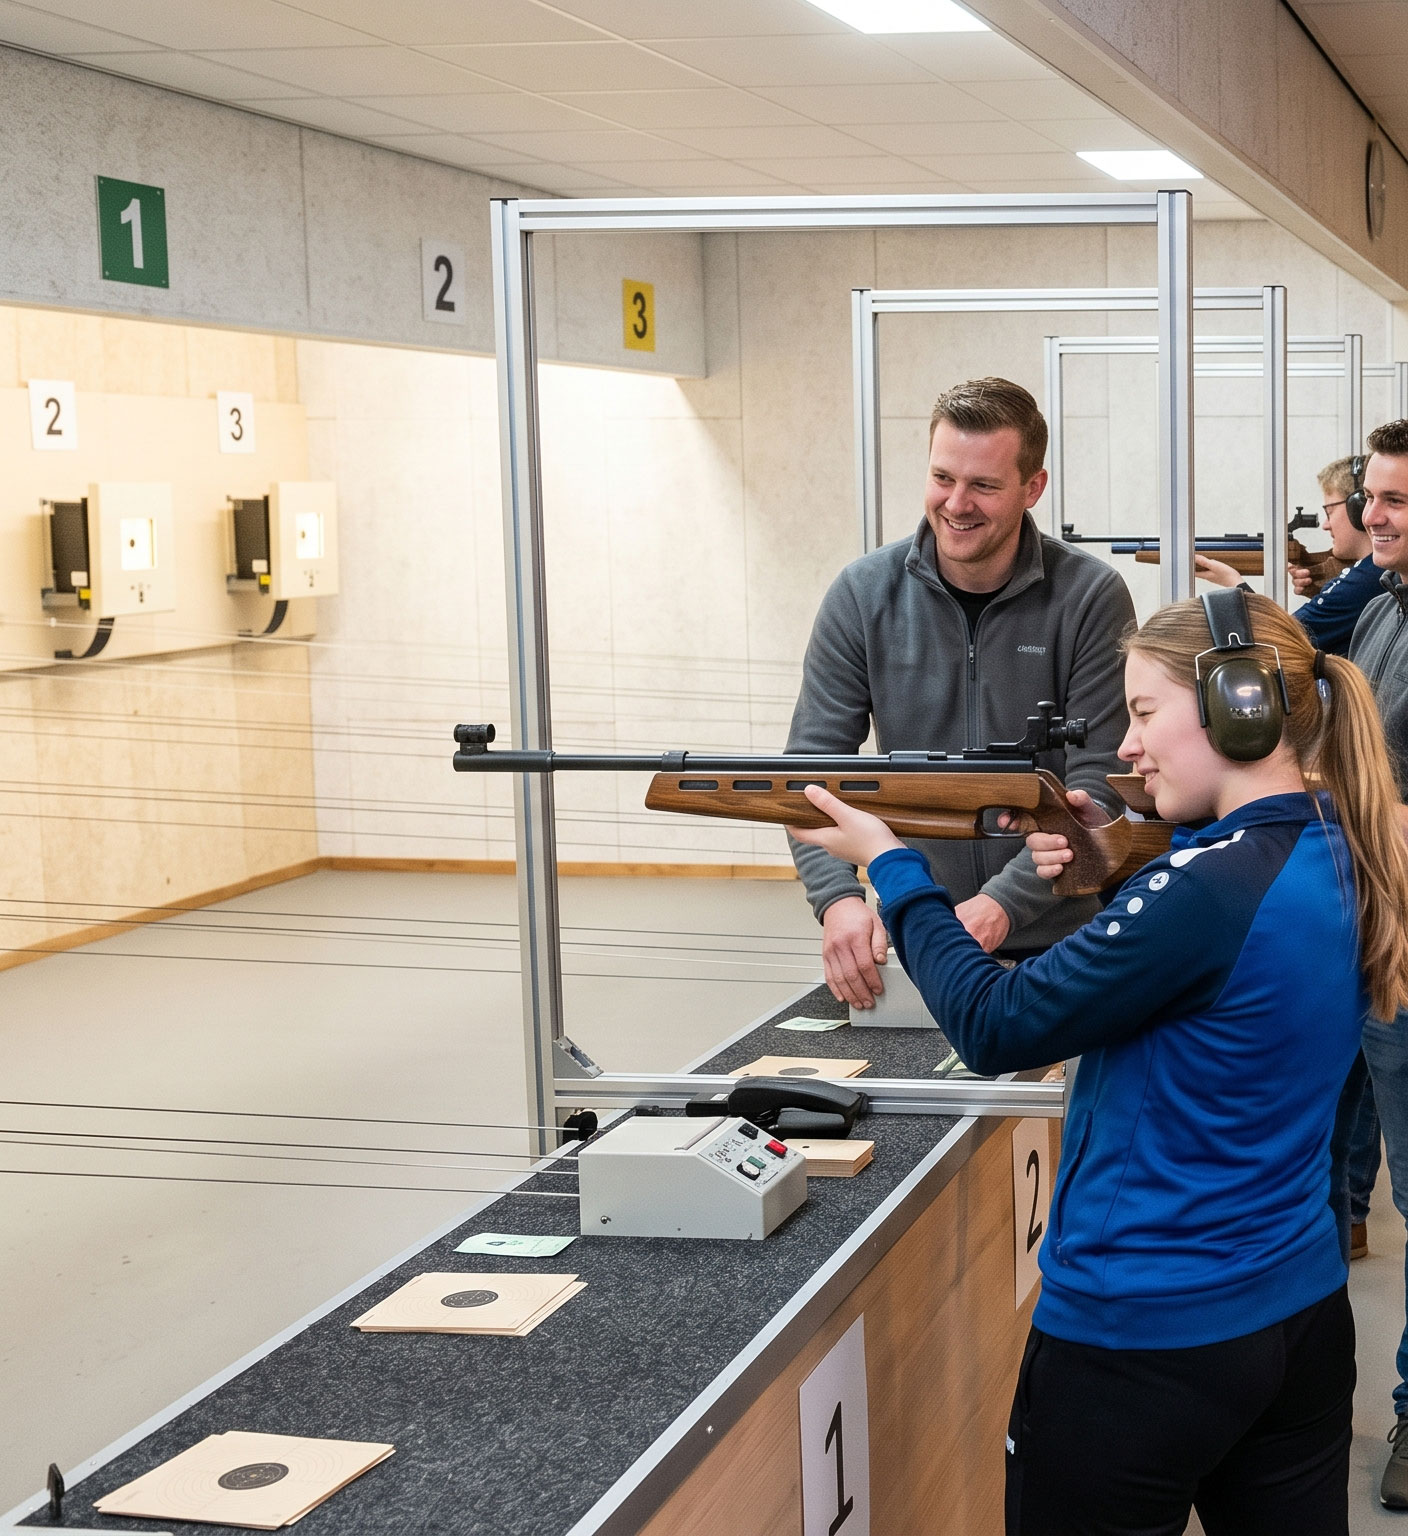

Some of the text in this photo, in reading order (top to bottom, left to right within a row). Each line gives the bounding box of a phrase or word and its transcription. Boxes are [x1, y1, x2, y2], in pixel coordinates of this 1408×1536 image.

[120, 198, 146, 269] 1
[433, 255, 457, 312] 2
[632, 291, 648, 339] 3
[45, 398, 63, 435] 2
[230, 408, 243, 442] 3
[1026, 1149, 1043, 1253] 2
[825, 1400, 854, 1536] 1
